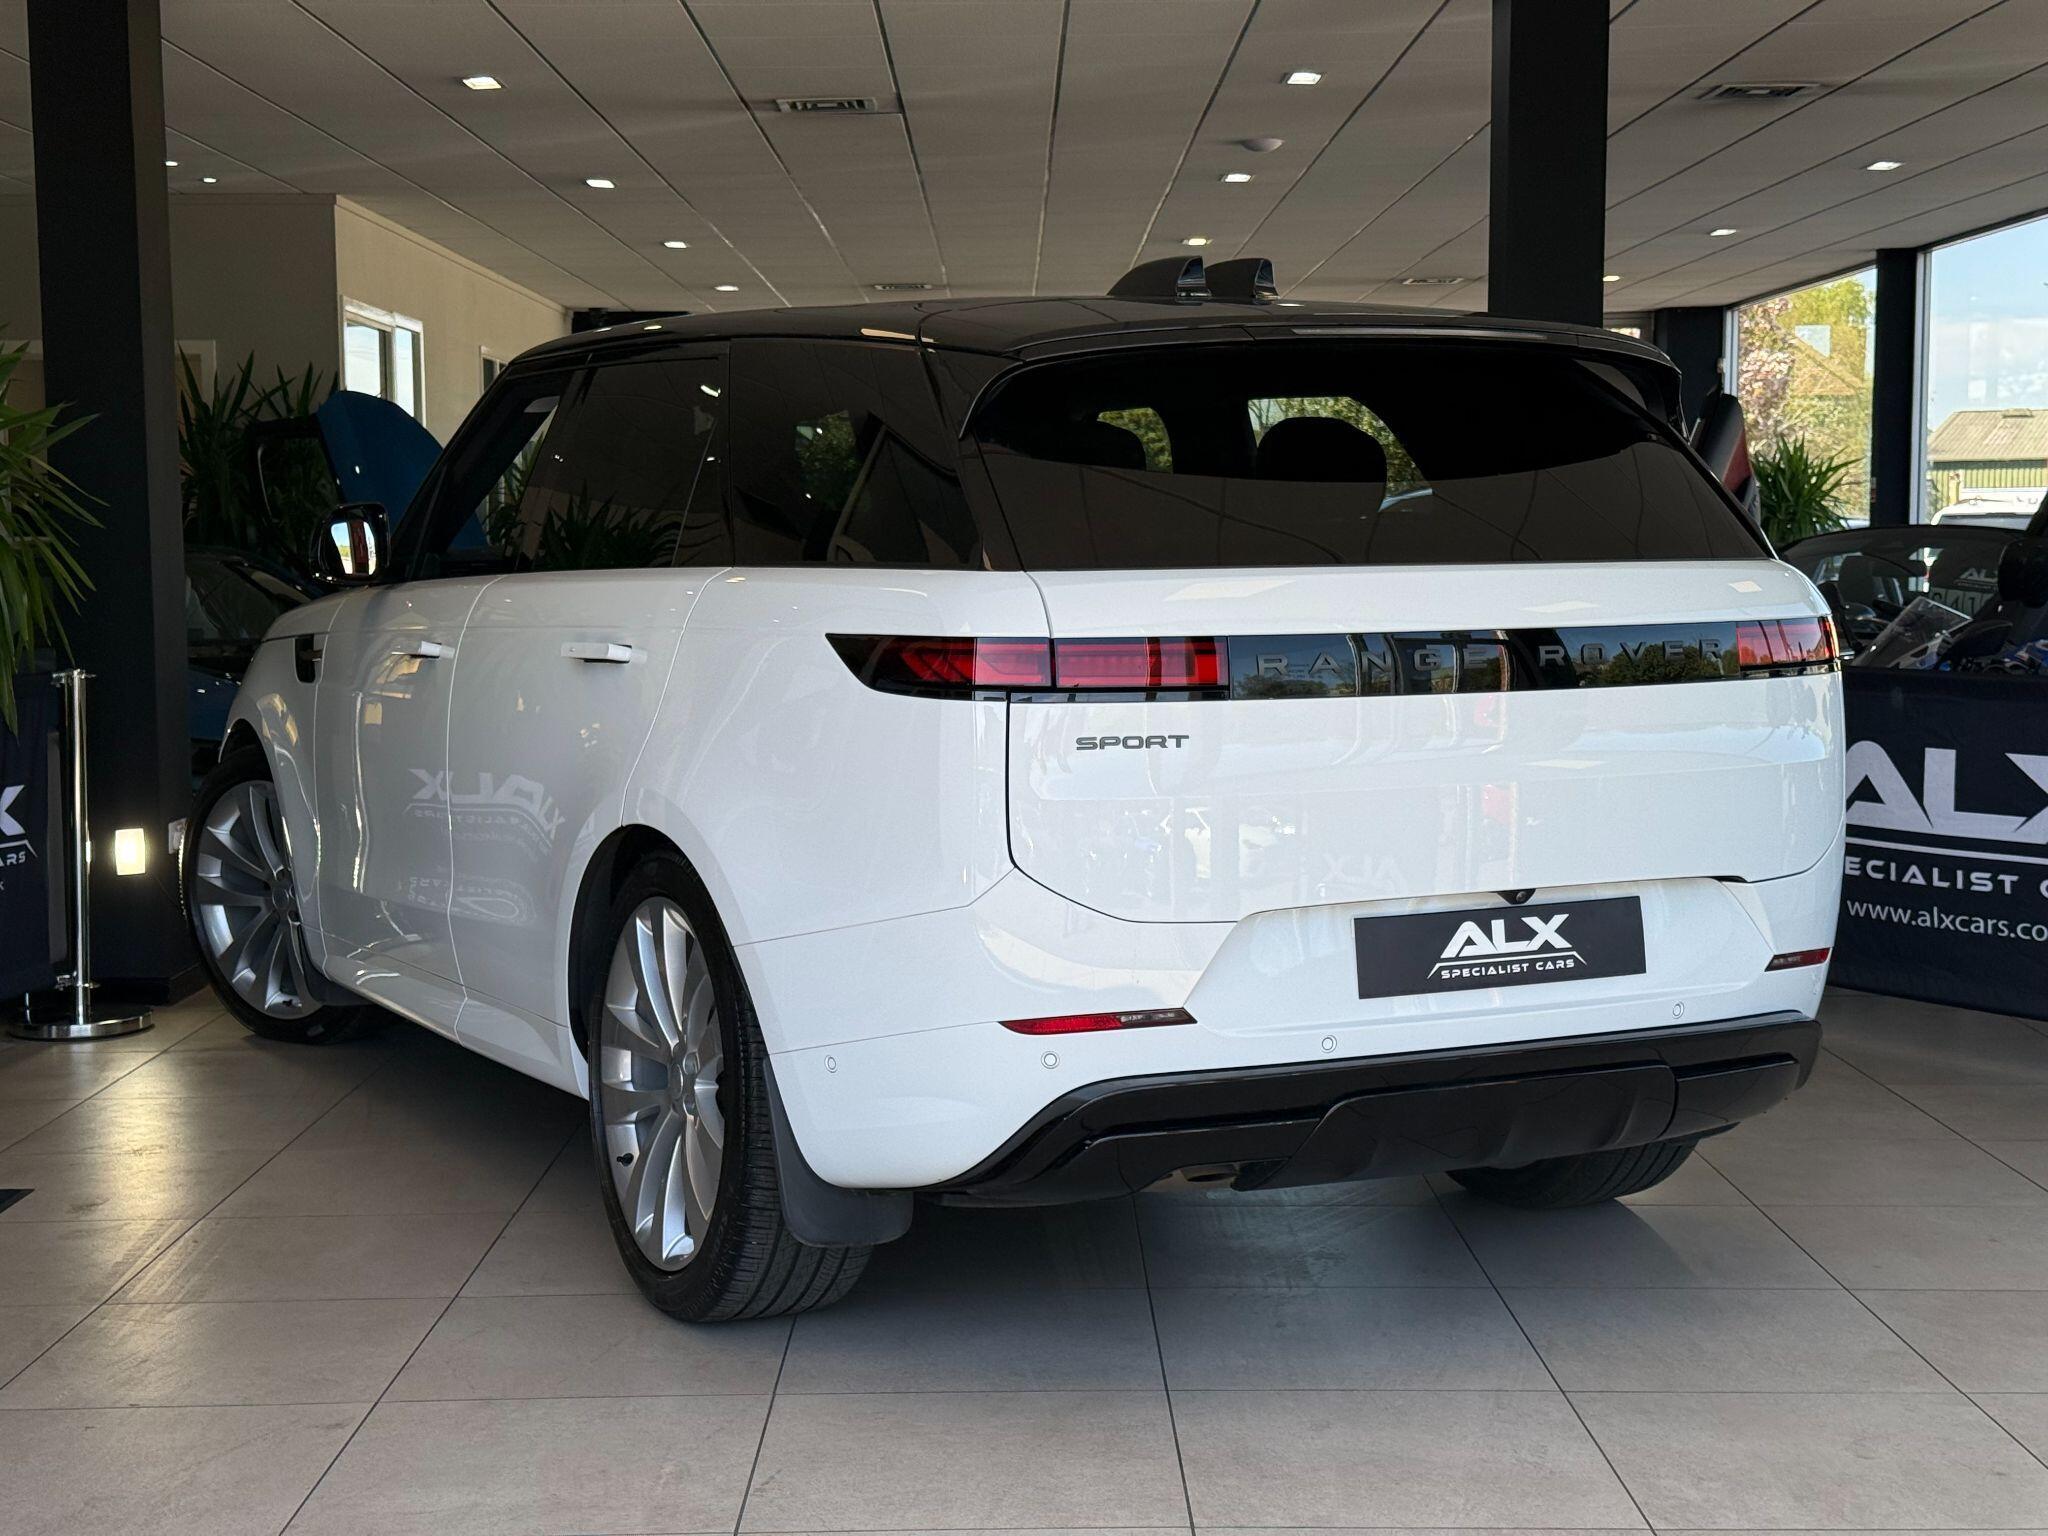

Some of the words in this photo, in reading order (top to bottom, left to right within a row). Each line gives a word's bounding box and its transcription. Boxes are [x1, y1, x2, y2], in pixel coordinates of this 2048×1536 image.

[1257, 644, 1488, 677] RANGE
[1538, 638, 1722, 668] ROVER
[1075, 735, 1190, 751] SPORT
[1440, 914, 1573, 959] ALX
[1440, 962, 1530, 980] SPECIALIST
[1535, 958, 1575, 972] CARS
